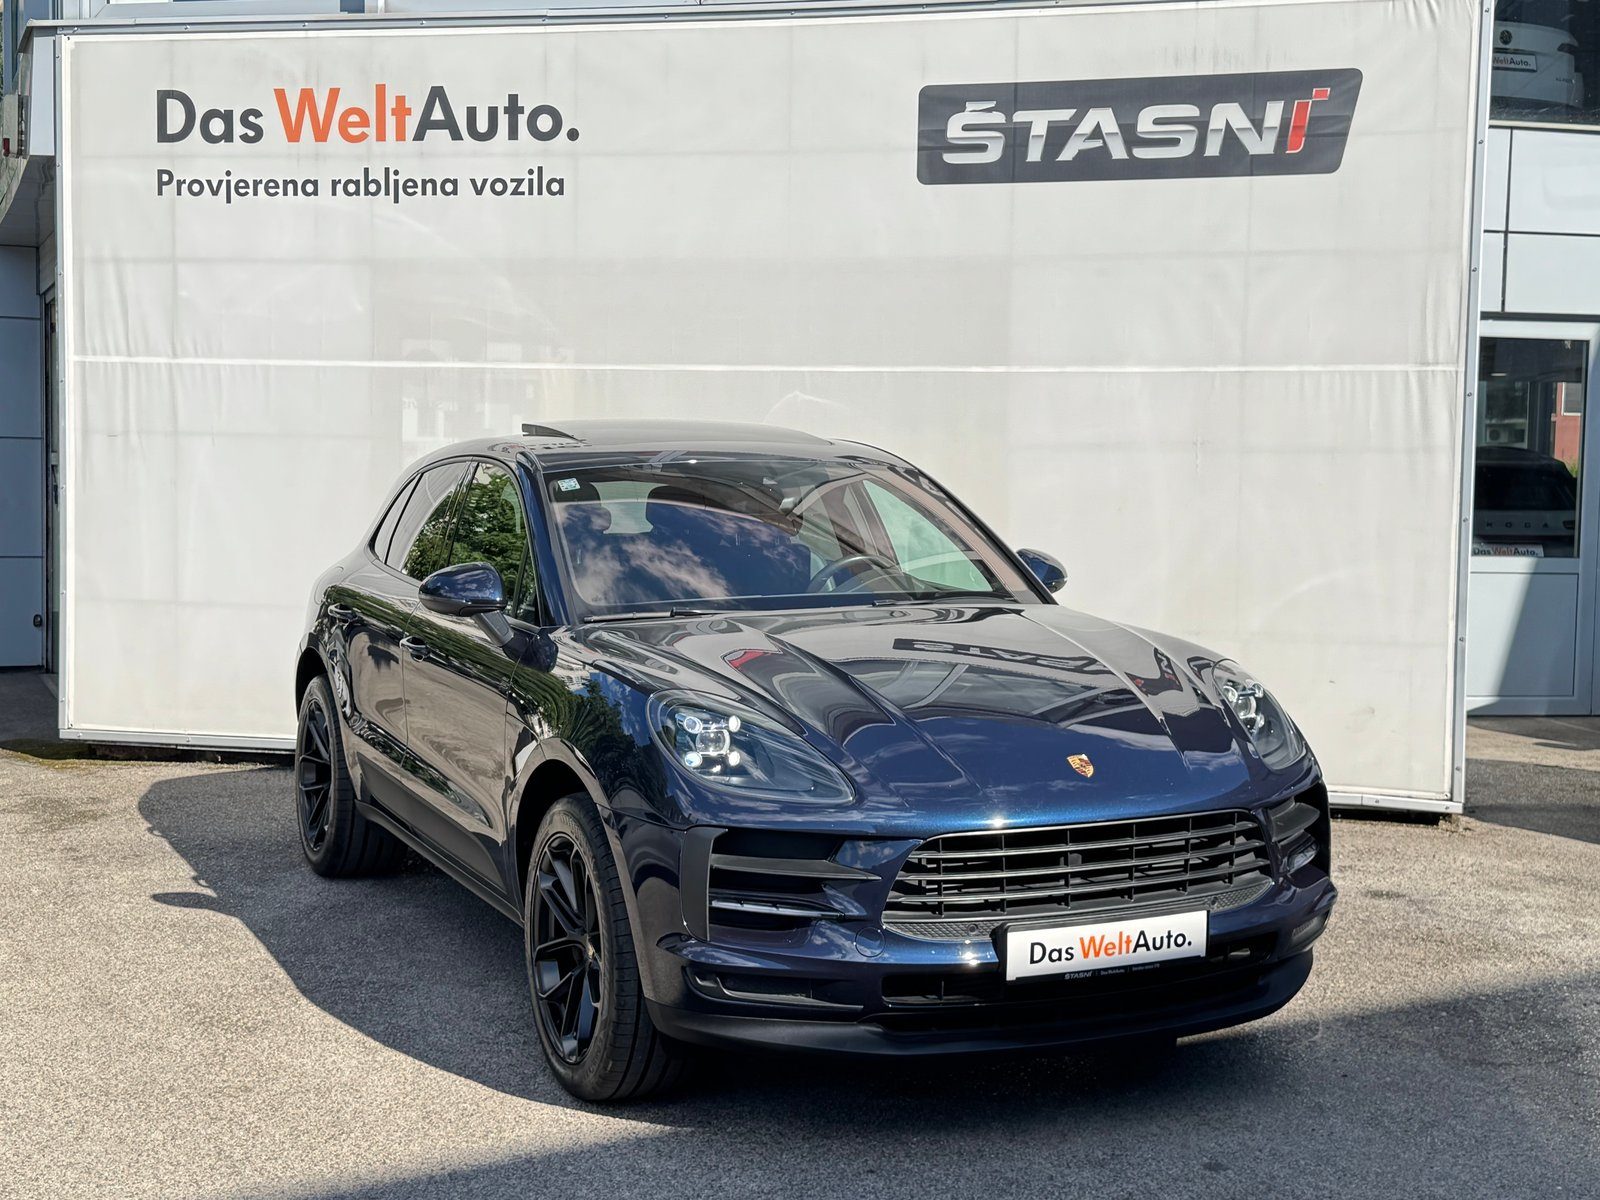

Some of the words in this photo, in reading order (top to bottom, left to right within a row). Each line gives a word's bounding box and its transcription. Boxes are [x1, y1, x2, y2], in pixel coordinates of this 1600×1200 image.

[156, 89, 264, 144] Das
[274, 84, 580, 143] WeltAuto.
[156, 168, 319, 204] Provjerena
[330, 167, 459, 204] rabljena
[469, 165, 566, 196] vozila
[1029, 942, 1074, 964] Das
[1079, 930, 1192, 959] WeltAuto.
